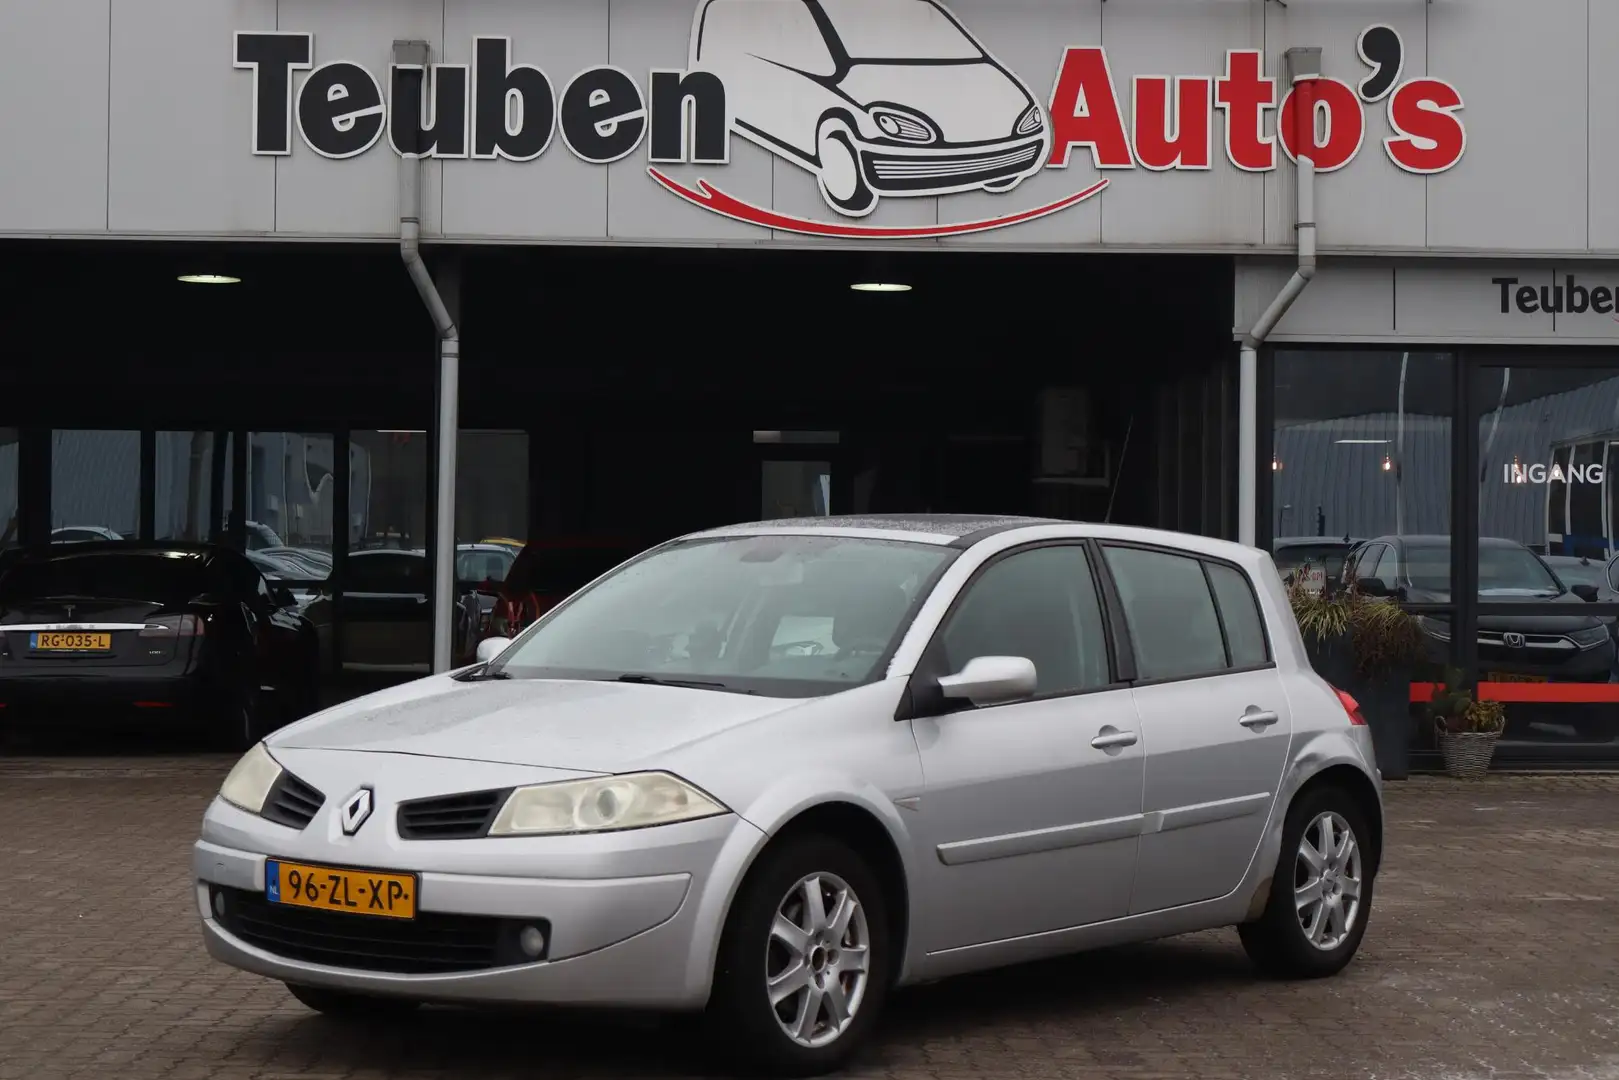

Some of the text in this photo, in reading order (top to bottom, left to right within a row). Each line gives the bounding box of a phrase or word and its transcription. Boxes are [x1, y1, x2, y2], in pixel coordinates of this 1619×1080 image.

[234, 24, 1467, 174] Teuben Auto's
[1492, 274, 1619, 314] Teube
[1503, 463, 1604, 484] INGANG
[41, 633, 105, 647] RG-035-L
[288, 869, 404, 911] 96-ZL-XP
